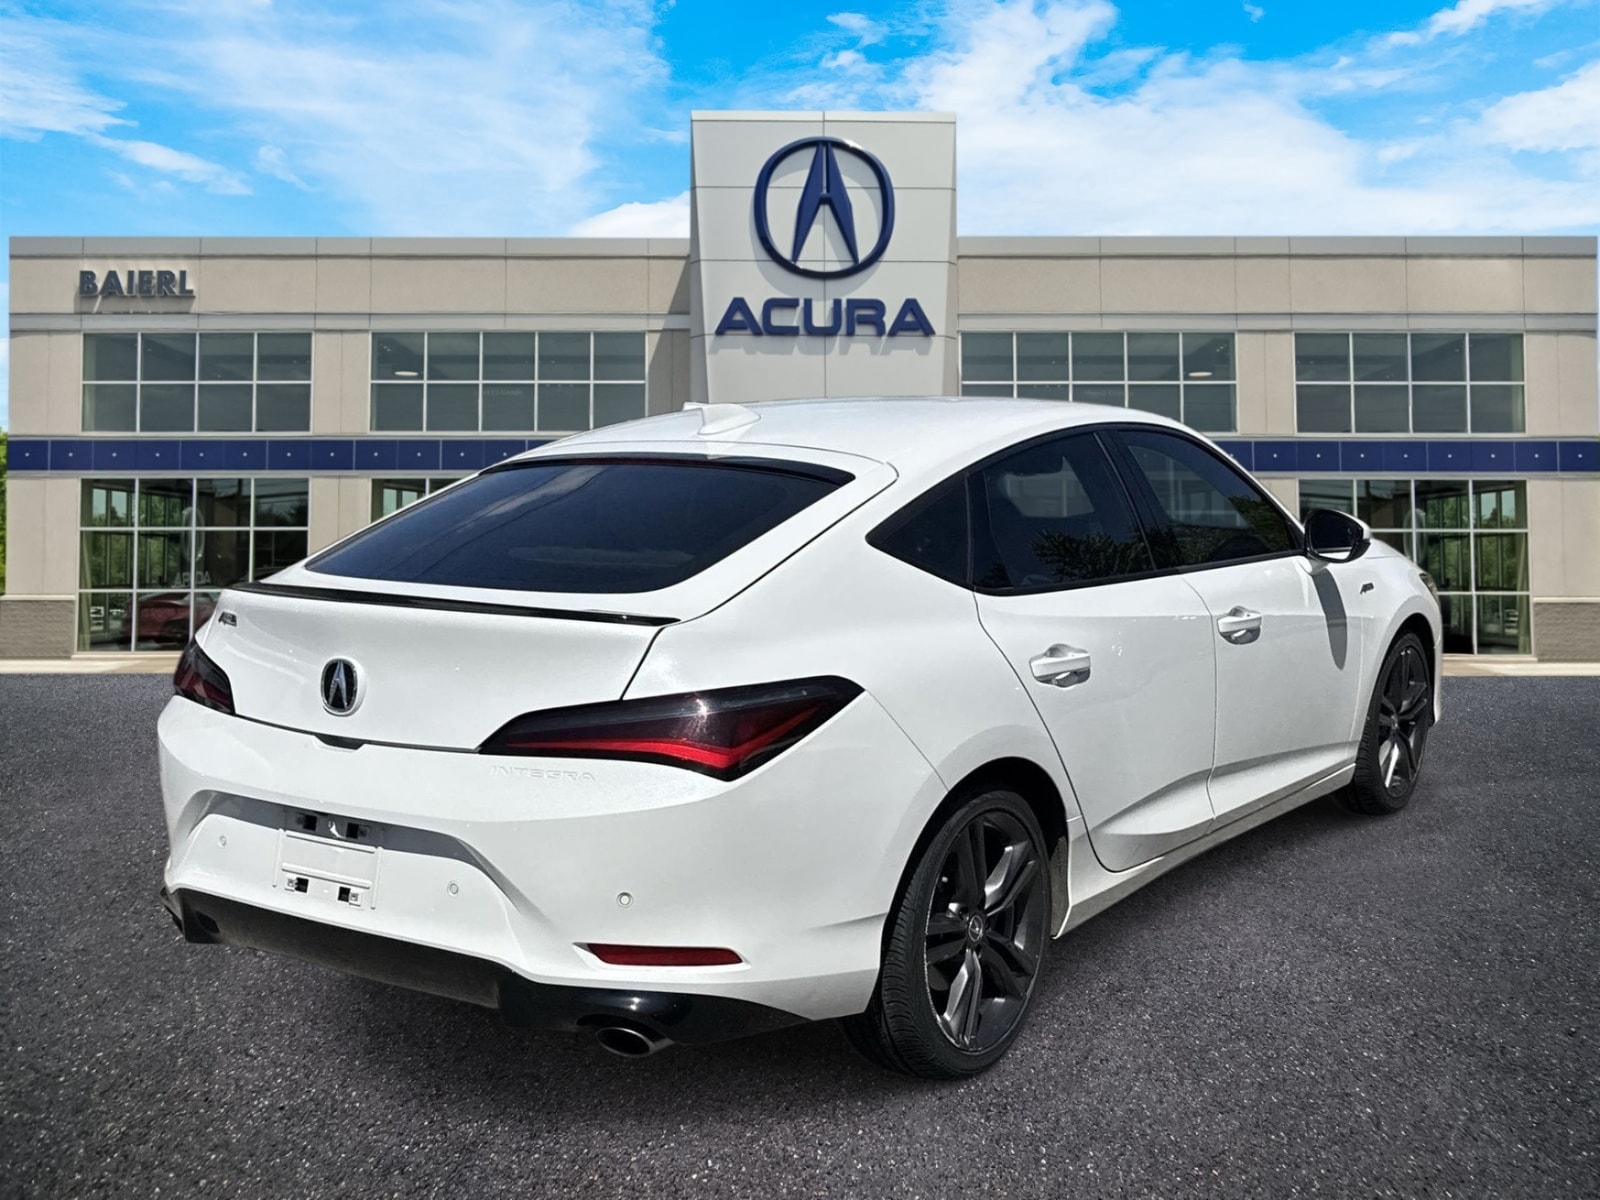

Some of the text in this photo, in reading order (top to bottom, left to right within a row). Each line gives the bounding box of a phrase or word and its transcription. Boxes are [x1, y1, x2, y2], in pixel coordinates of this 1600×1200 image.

[79, 269, 195, 296] BAIERL
[714, 297, 936, 336] ACURA
[490, 764, 597, 782] INTEGRA
